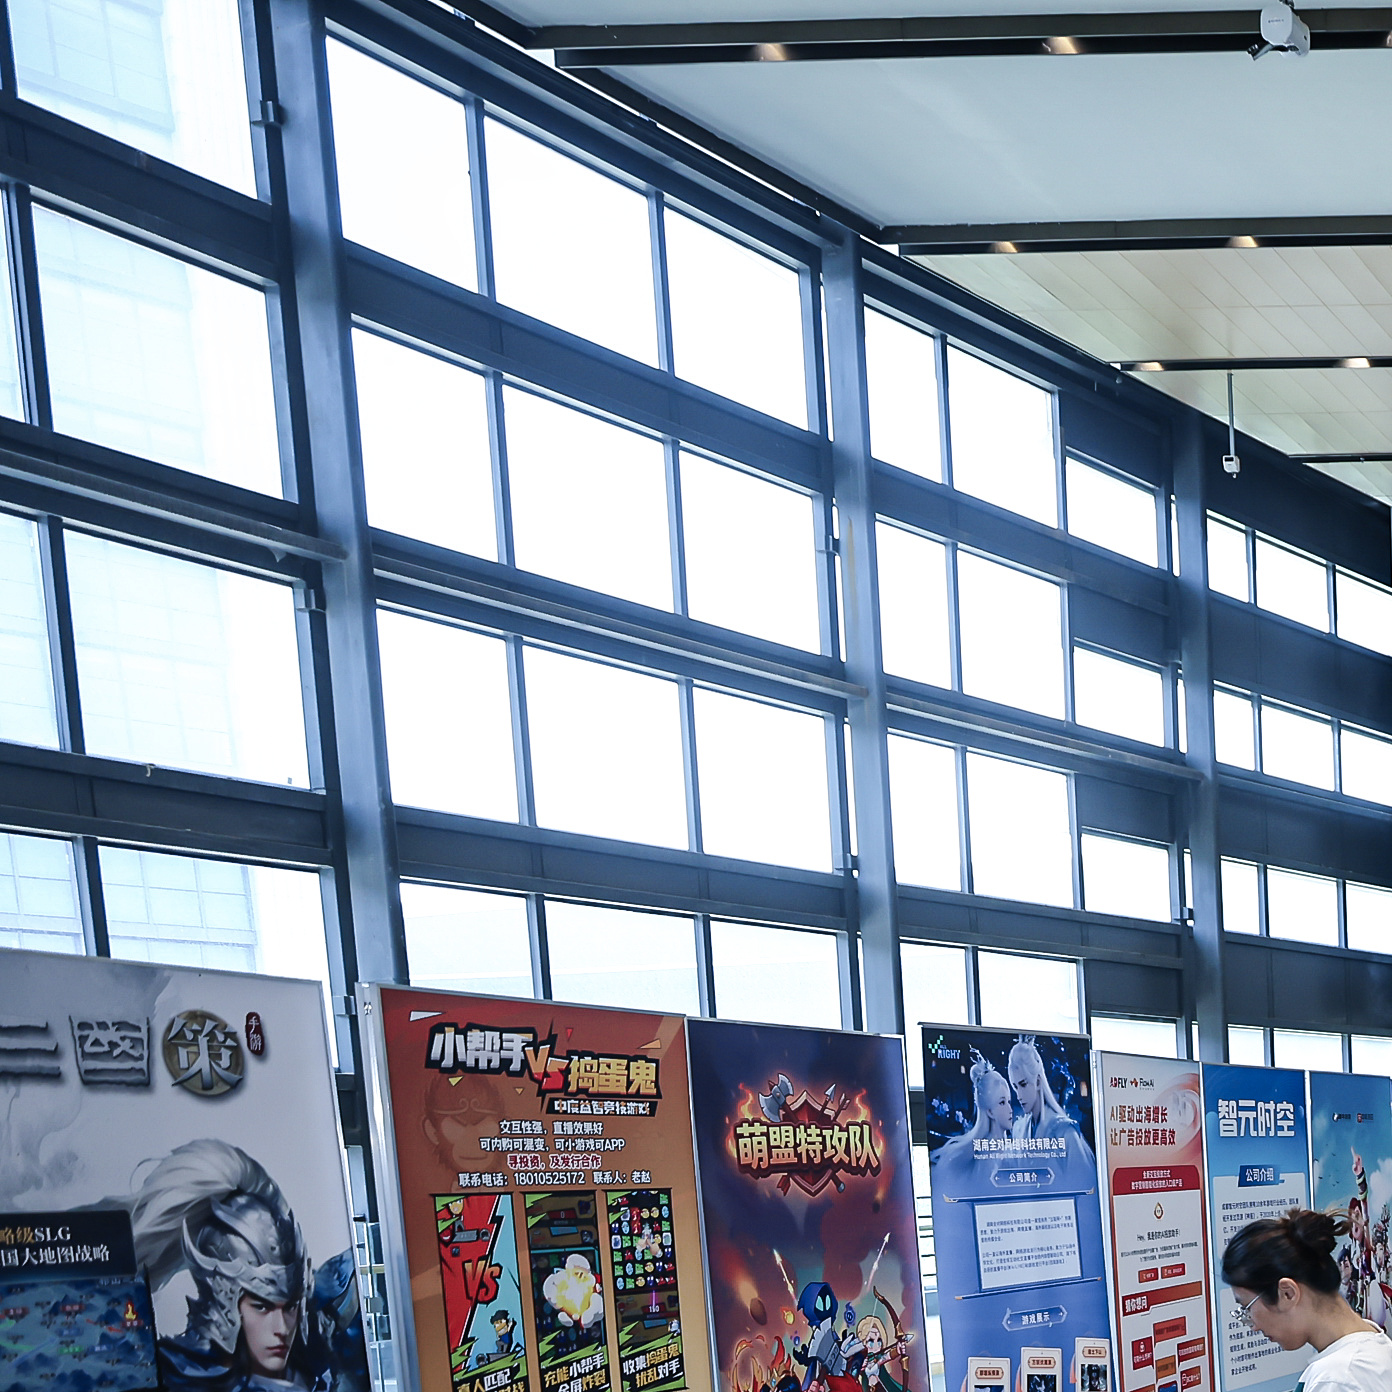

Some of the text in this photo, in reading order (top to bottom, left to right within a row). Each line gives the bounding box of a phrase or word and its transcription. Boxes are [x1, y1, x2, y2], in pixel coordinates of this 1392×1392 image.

[430, 1026, 533, 1072] 小帮手
[568, 1056, 657, 1095] 捣蛋鬼
[1110, 1105, 1168, 1124] AI驱动出海增长
[1218, 1099, 1295, 1137] 智元时空
[736, 1122, 879, 1170] 萌盟特攻队
[972, 1137, 1066, 1152] 湖南全对网络科技有限公司
[1110, 1128, 1176, 1147] 让广告投放更高效
[1009, 1172, 1038, 1183] 公司简介
[1246, 1168, 1274, 1182] 公司介绍
[1022, 1312, 1050, 1325] 游戏展示
[543, 1352, 605, 1387] 充能小帮手
[622, 1343, 680, 1374] 收集捣蛋鬼
[635, 1359, 680, 1388] 扰乱对手
